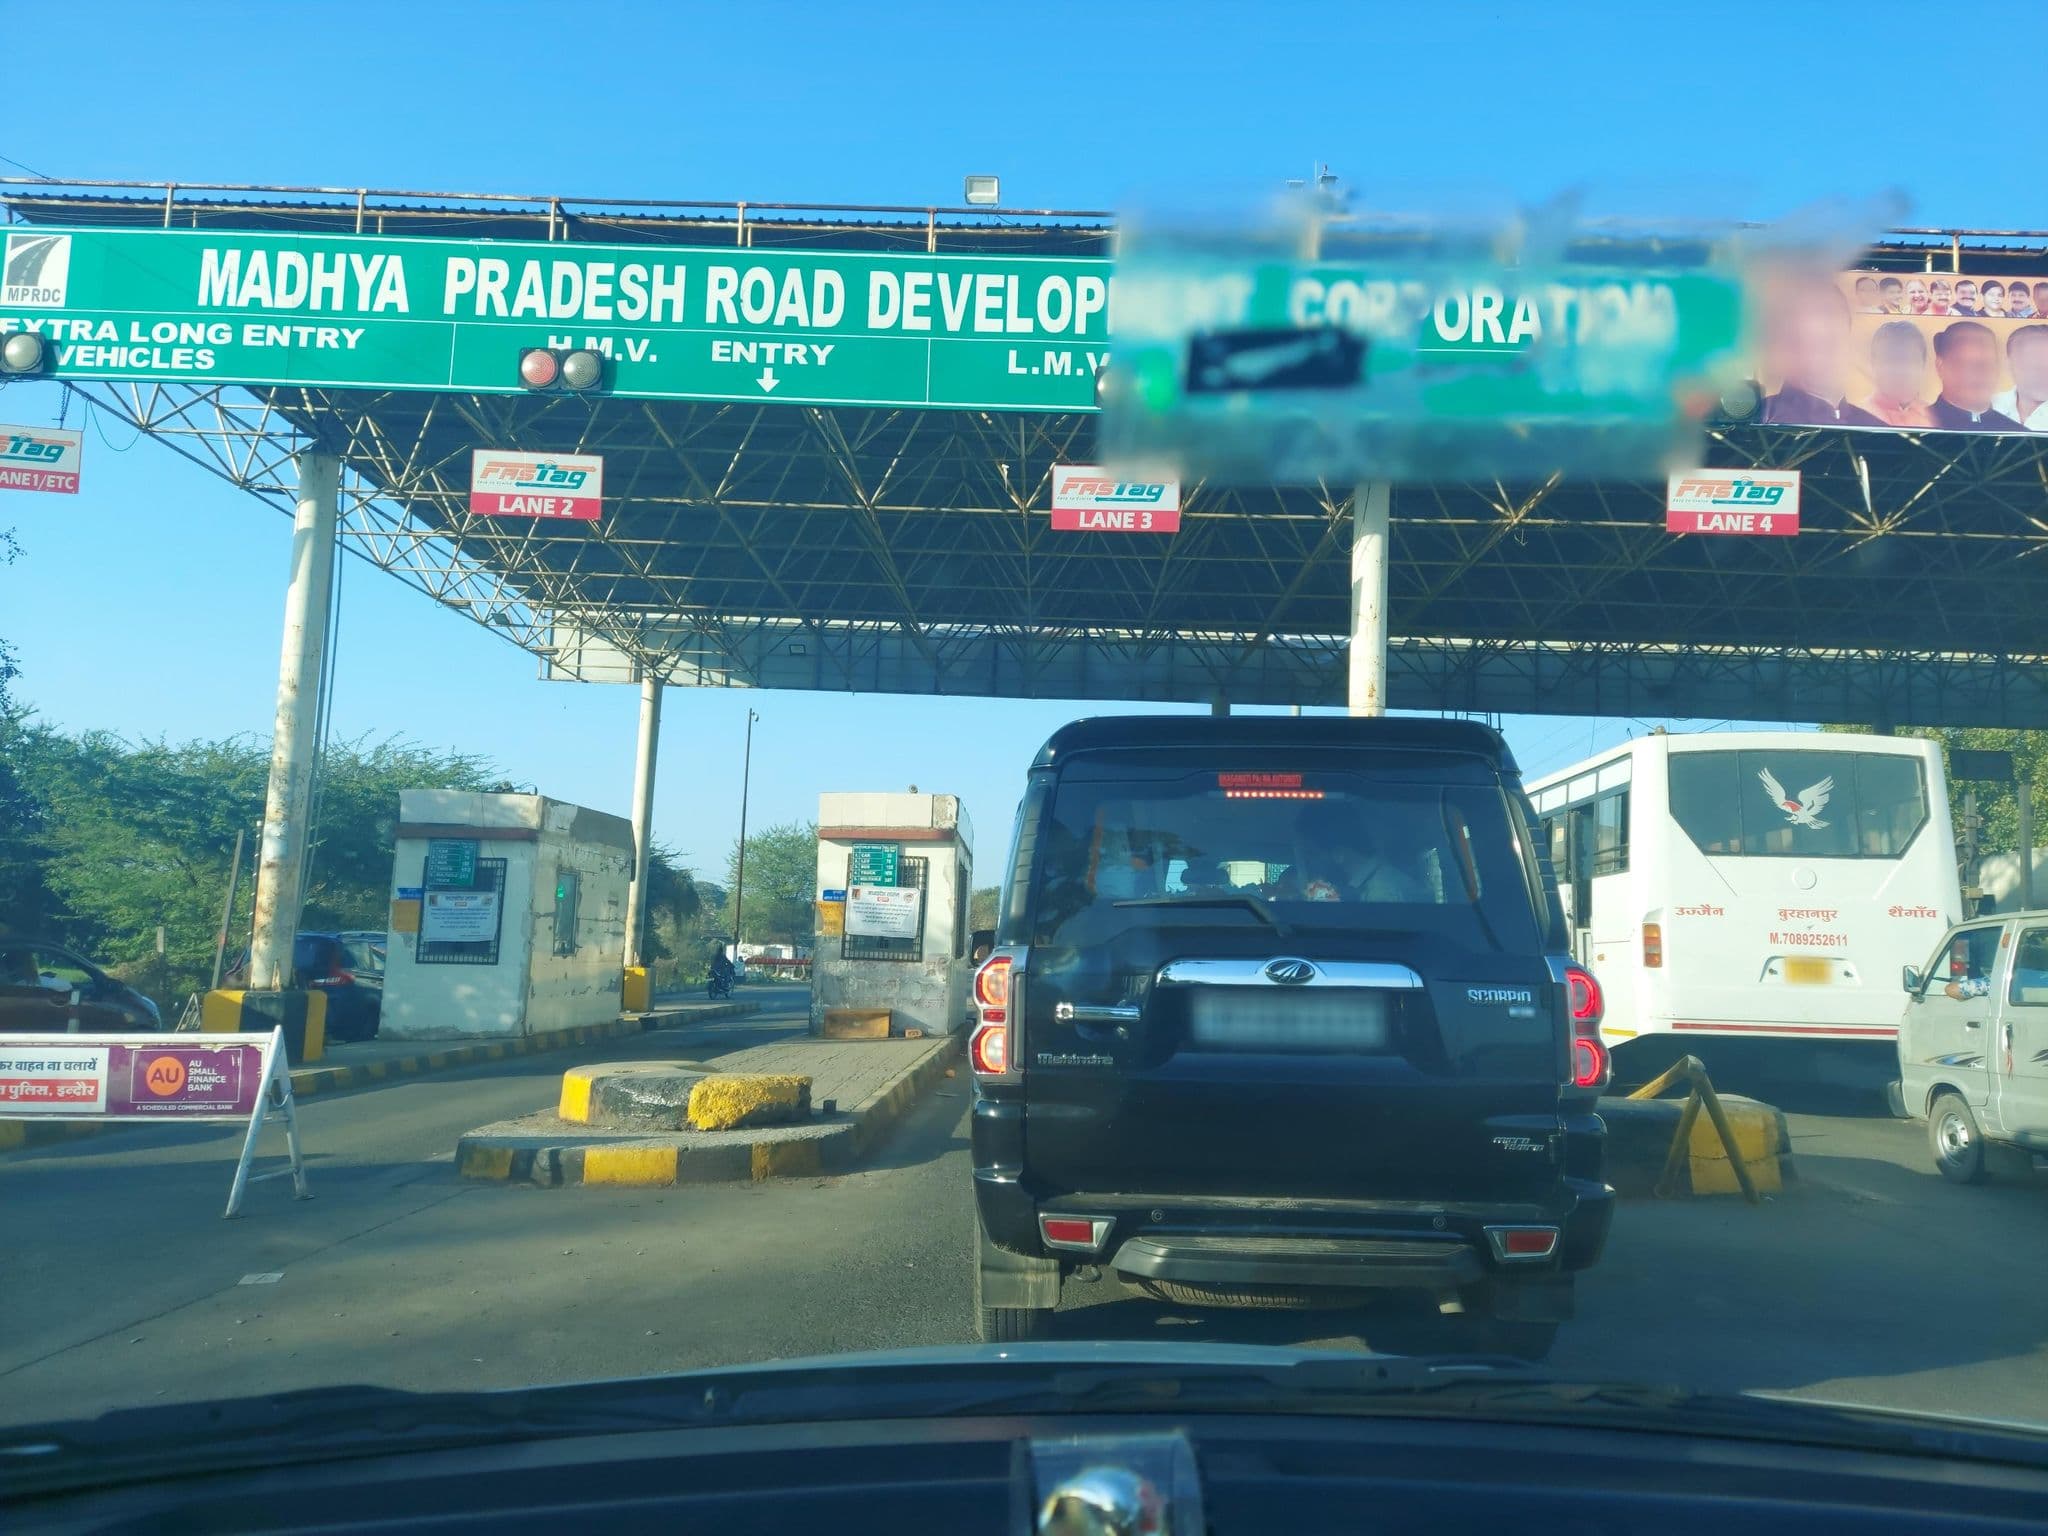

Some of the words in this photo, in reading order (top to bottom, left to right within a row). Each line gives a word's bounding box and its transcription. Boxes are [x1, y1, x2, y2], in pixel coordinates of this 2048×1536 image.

[8, 287, 61, 303] MPRDC
[198, 248, 408, 313] MADHYA
[444, 257, 686, 323] PRADESH
[705, 266, 845, 328] ROAD
[130, 321, 232, 345] LONG
[243, 324, 364, 350] ENTRY
[55, 345, 215, 370] VEHICLES
[547, 335, 657, 364] HM.V.
[711, 340, 835, 365] ENTRY
[480, 461, 588, 489] FASTag
[1060, 477, 1165, 502] FASTag
[1676, 479, 1784, 505] FASTag
[499, 495, 556, 514] LANE
[561, 499, 574, 515] 2
[1079, 511, 1135, 528] LANE
[1140, 512, 1152, 529] 3
[1697, 513, 1755, 531] LANE
[1760, 515, 1772, 532] 4
[1675, 904, 1725, 916] उज्जैन
[1778, 908, 1838, 922] बुरहानपुर
[1769, 932, 1848, 946] M.7089252611
[15, 1061, 44, 1072] वाहन
[47, 1061, 61, 1071] ना
[64, 1057, 98, 1071] चलायें
[150, 1067, 180, 1083] AU
[187, 1084, 213, 1092] BANK
